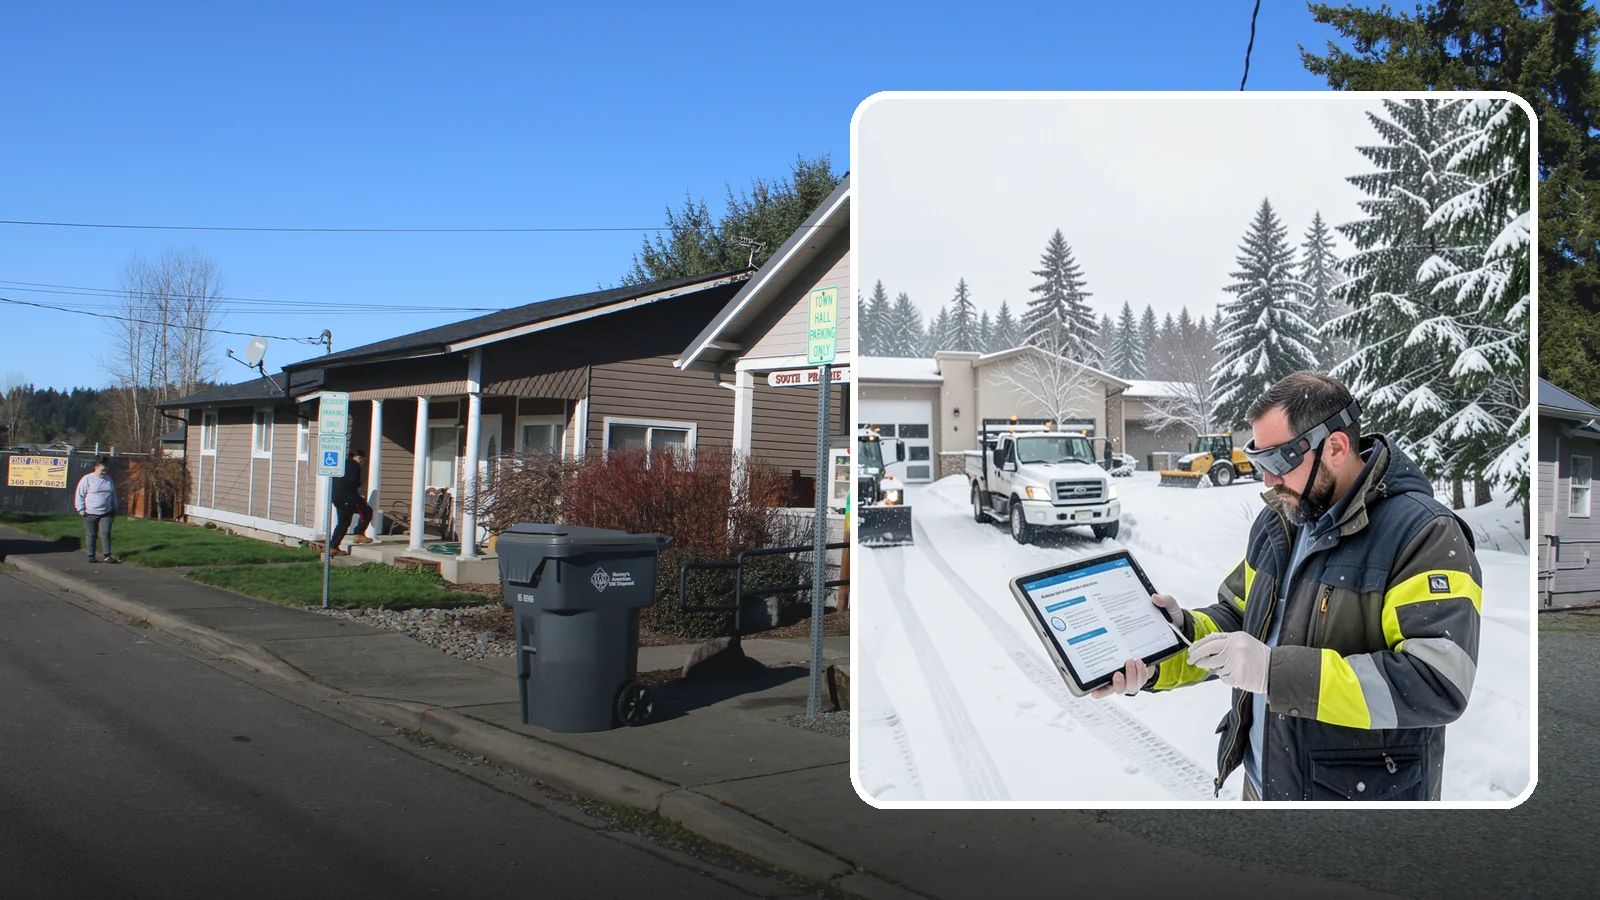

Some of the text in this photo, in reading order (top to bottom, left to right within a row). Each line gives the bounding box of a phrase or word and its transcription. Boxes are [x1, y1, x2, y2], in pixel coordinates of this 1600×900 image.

[815, 294, 832, 307] TOWN
[814, 311, 831, 324] HALL
[810, 327, 836, 340] PARKING
[813, 344, 831, 357] ONLY
[775, 373, 801, 384] SOUTH
[323, 409, 345, 417] PARKING
